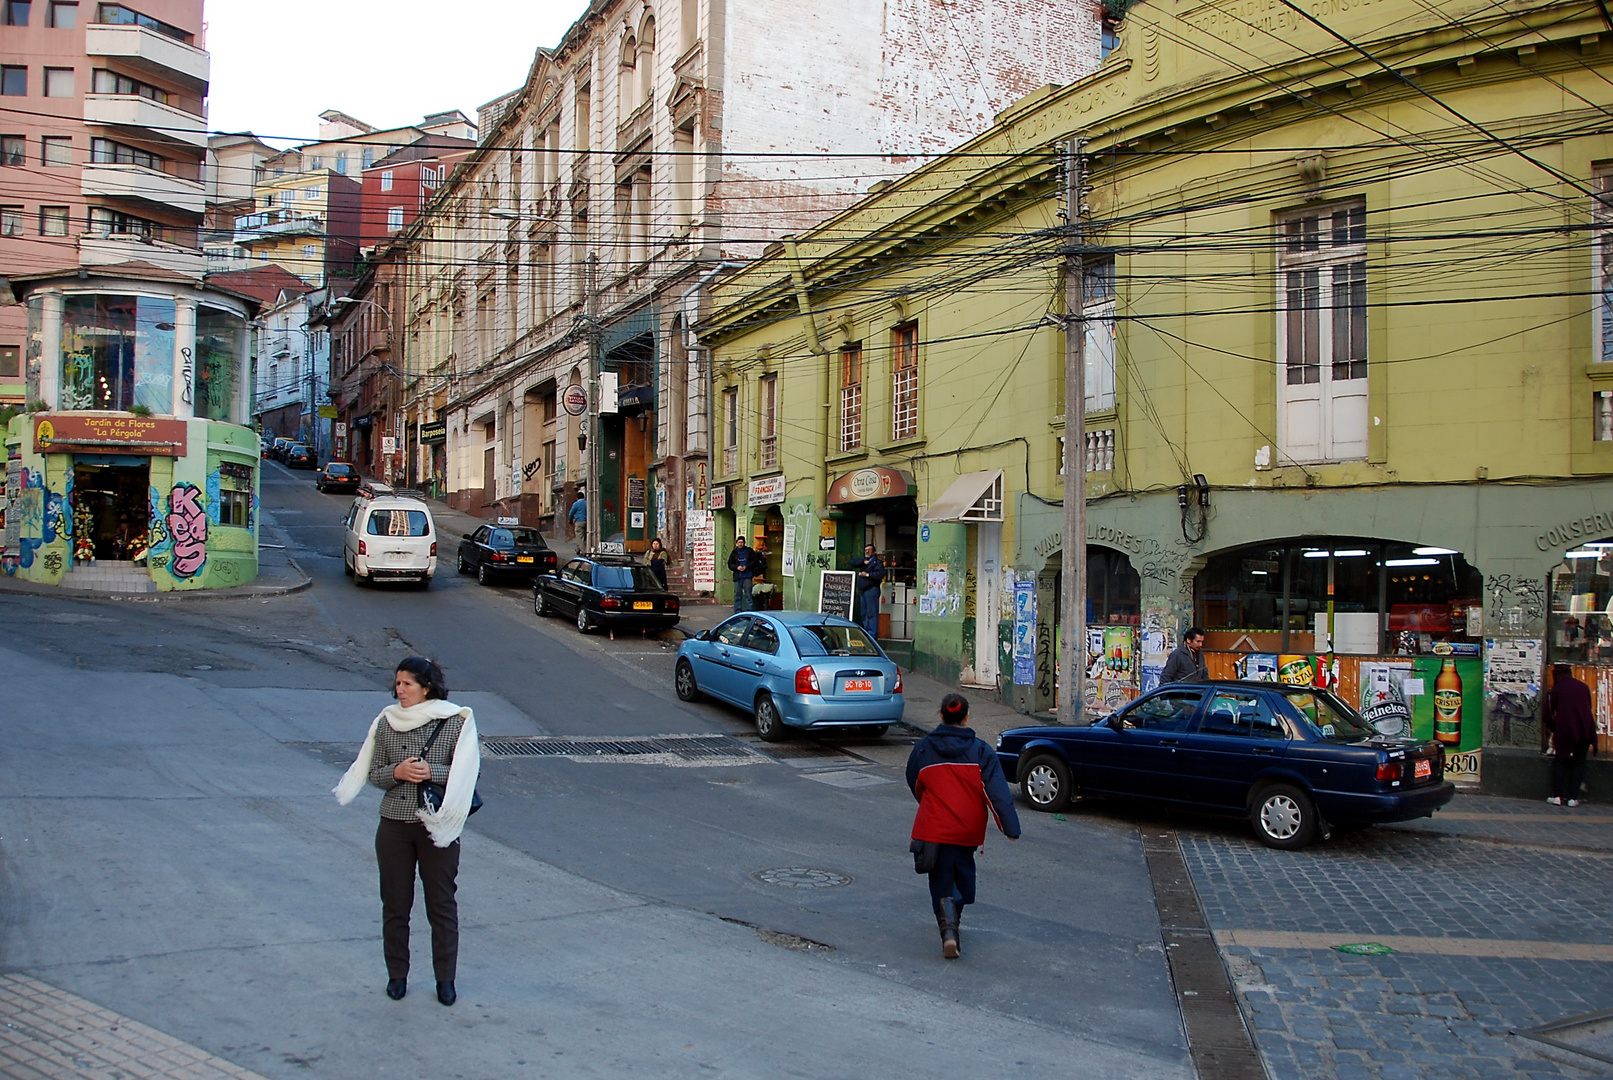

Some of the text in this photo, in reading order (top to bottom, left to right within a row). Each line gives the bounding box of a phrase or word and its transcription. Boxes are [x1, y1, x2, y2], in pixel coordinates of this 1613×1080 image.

[114, 418, 126, 427] de
[128, 419, 156, 429] Flores
[1086, 523, 1144, 554] LICORES
[1282, 669, 1314, 684] CRISTAL
[1435, 697, 1462, 707] CRISTAL
[1362, 703, 1408, 721] Heineken
[1444, 754, 1478, 773] $850
